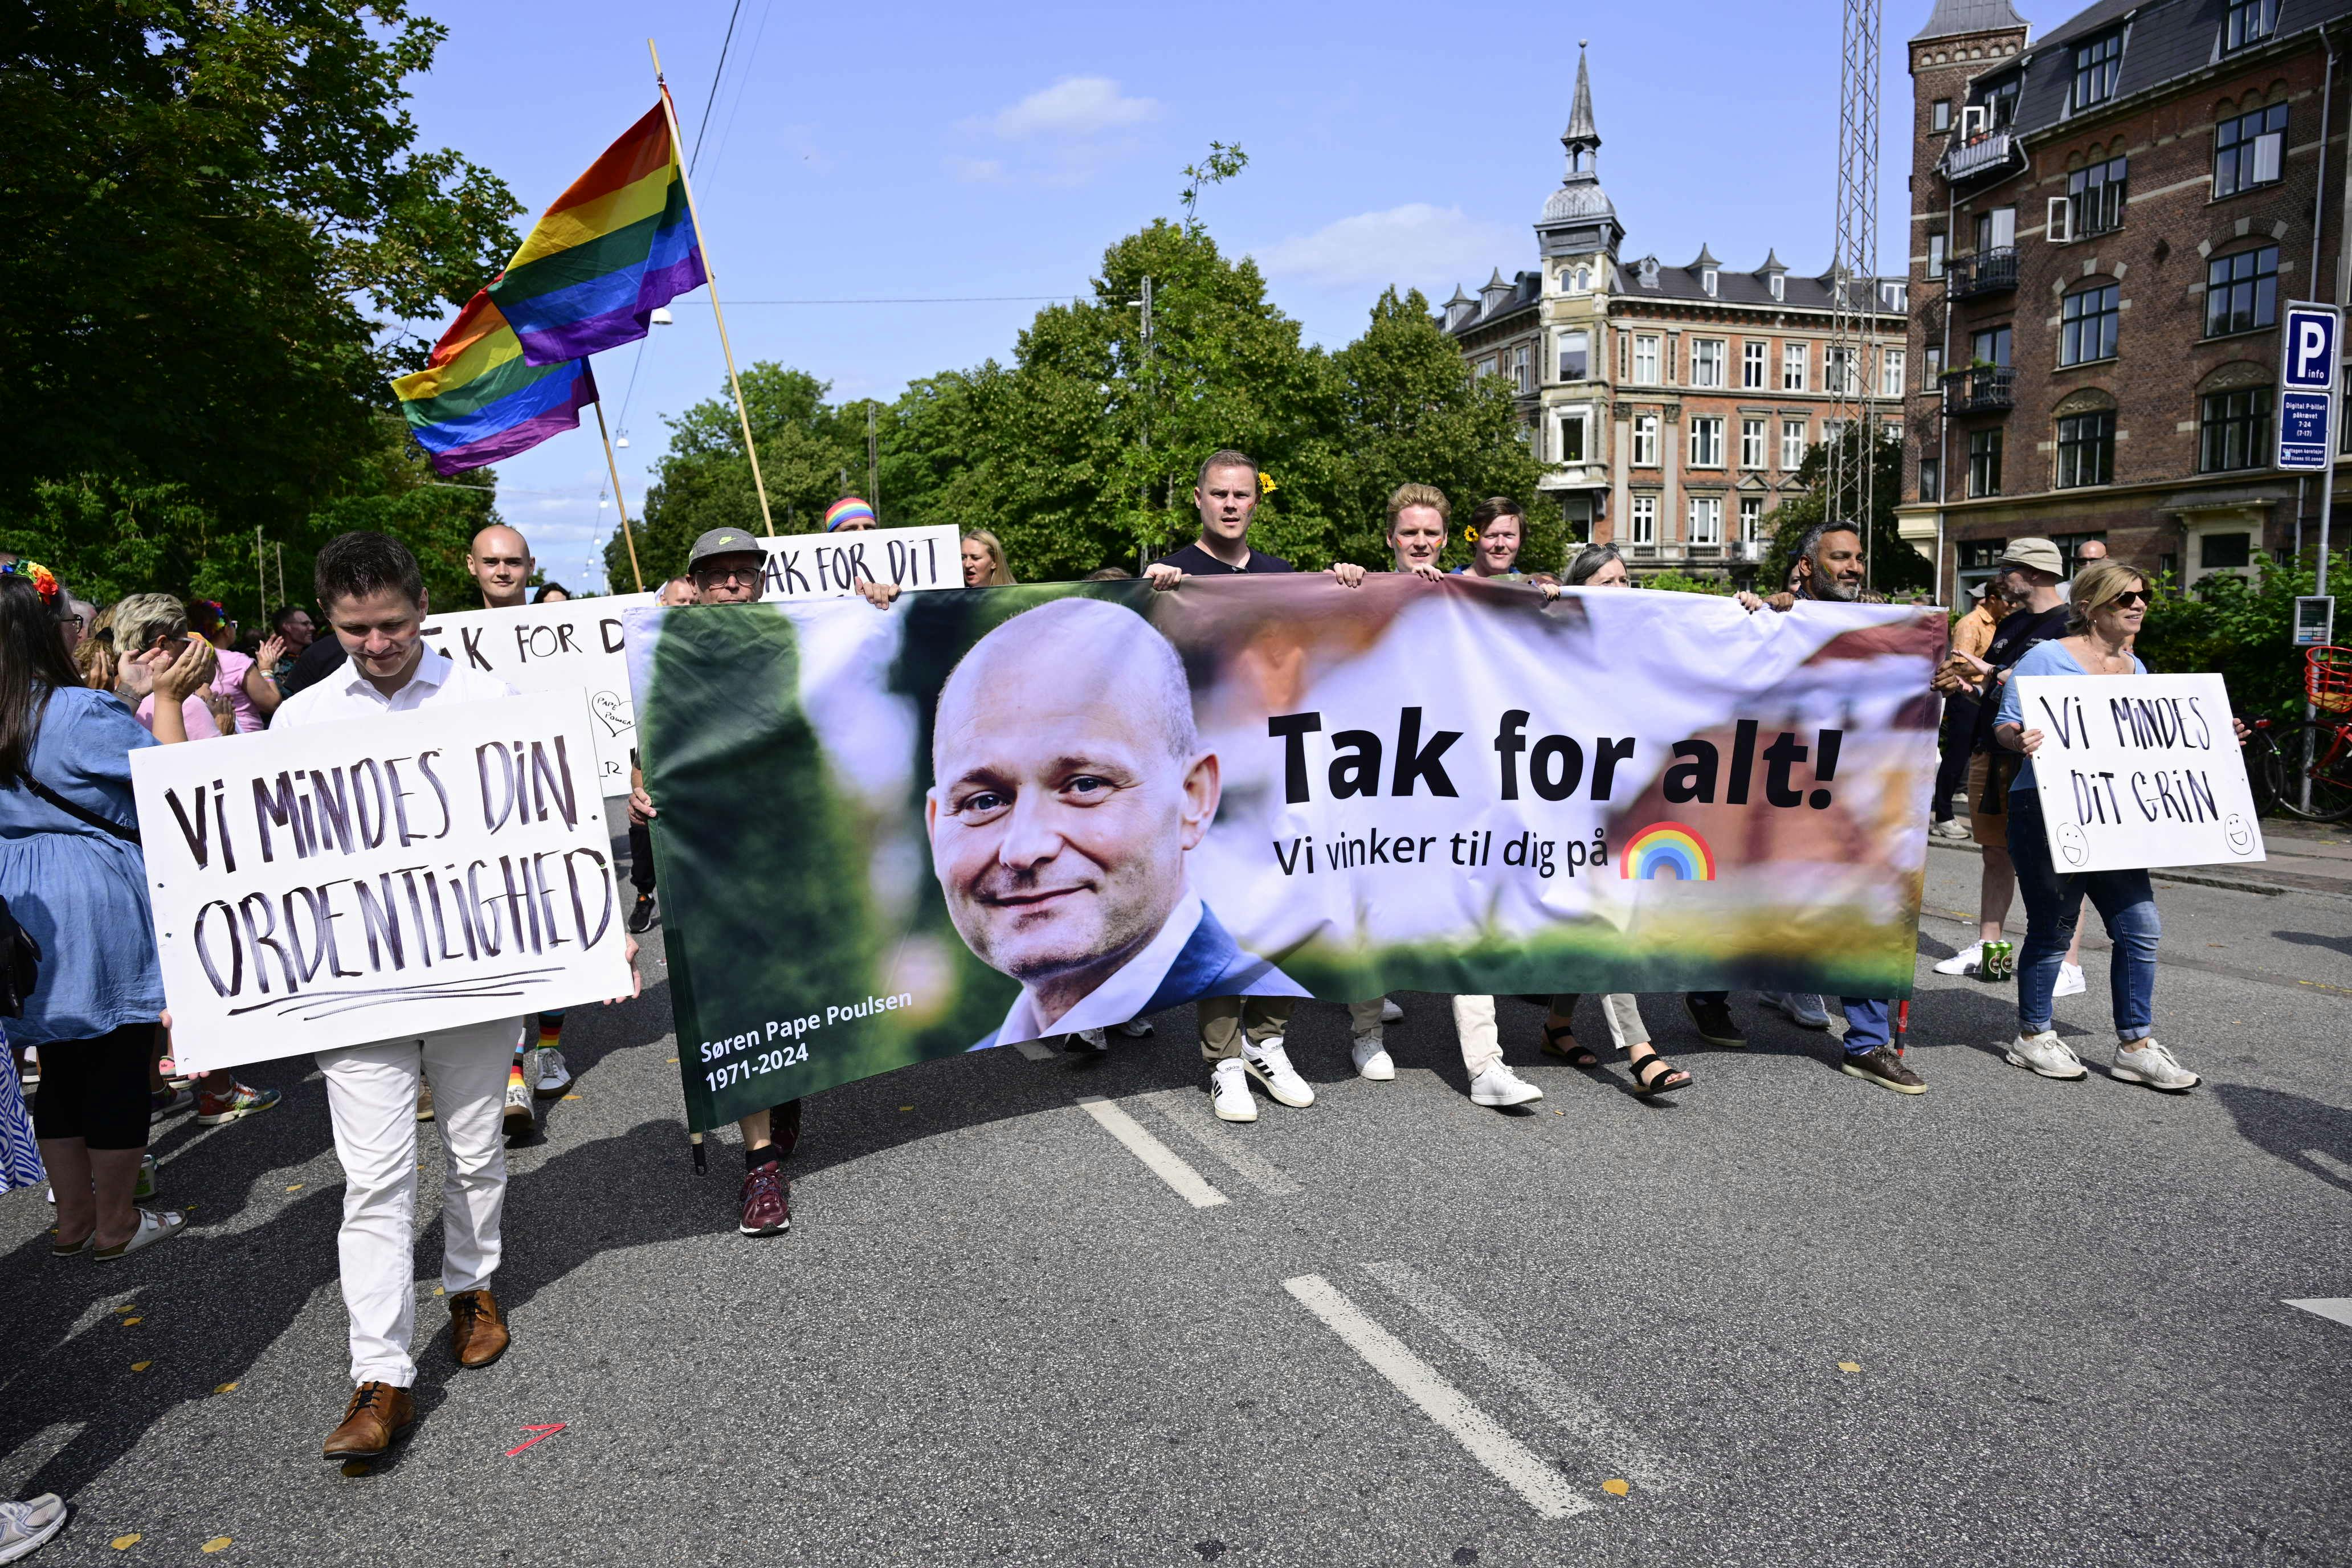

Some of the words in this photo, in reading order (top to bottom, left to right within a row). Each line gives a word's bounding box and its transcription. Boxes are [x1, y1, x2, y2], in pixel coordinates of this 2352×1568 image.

[2297, 321, 2325, 378] P
[2308, 370, 2324, 379] info
[814, 542, 876, 591] FOR
[515, 624, 583, 663] FOR
[597, 697, 618, 710] PAPE
[605, 712, 631, 725] POWER
[1268, 707, 1464, 804] Tak
[1494, 709, 1636, 801] for
[1663, 719, 1843, 810] alt!
[1273, 835, 1314, 875] Vi
[1326, 828, 1436, 870] vinker
[1449, 831, 1491, 866] til
[1503, 831, 1555, 878] dig
[1567, 827, 1608, 877] på
[701, 1028, 760, 1063] Søren
[766, 1014, 820, 1042] Pape
[827, 991, 912, 1025] Poulsen
[705, 1043, 809, 1092] 1971-2024
